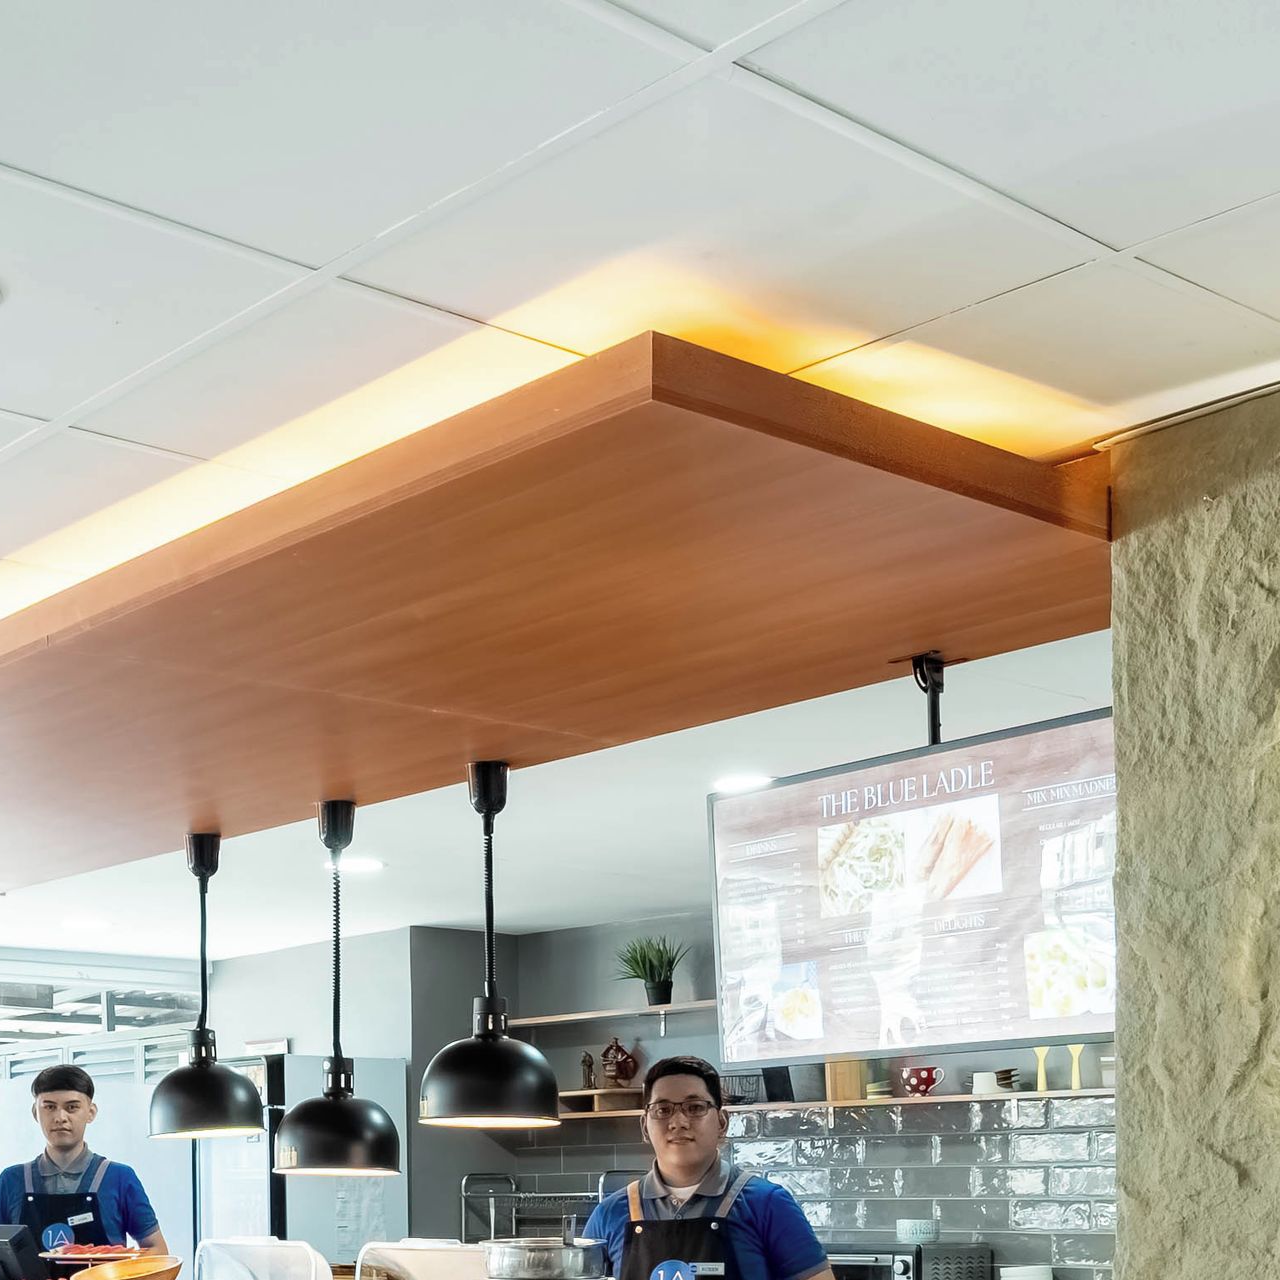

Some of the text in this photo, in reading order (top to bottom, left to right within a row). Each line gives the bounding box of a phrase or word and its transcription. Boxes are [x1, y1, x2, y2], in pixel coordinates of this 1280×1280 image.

[818, 760, 996, 818] THE BLUE LADLE
